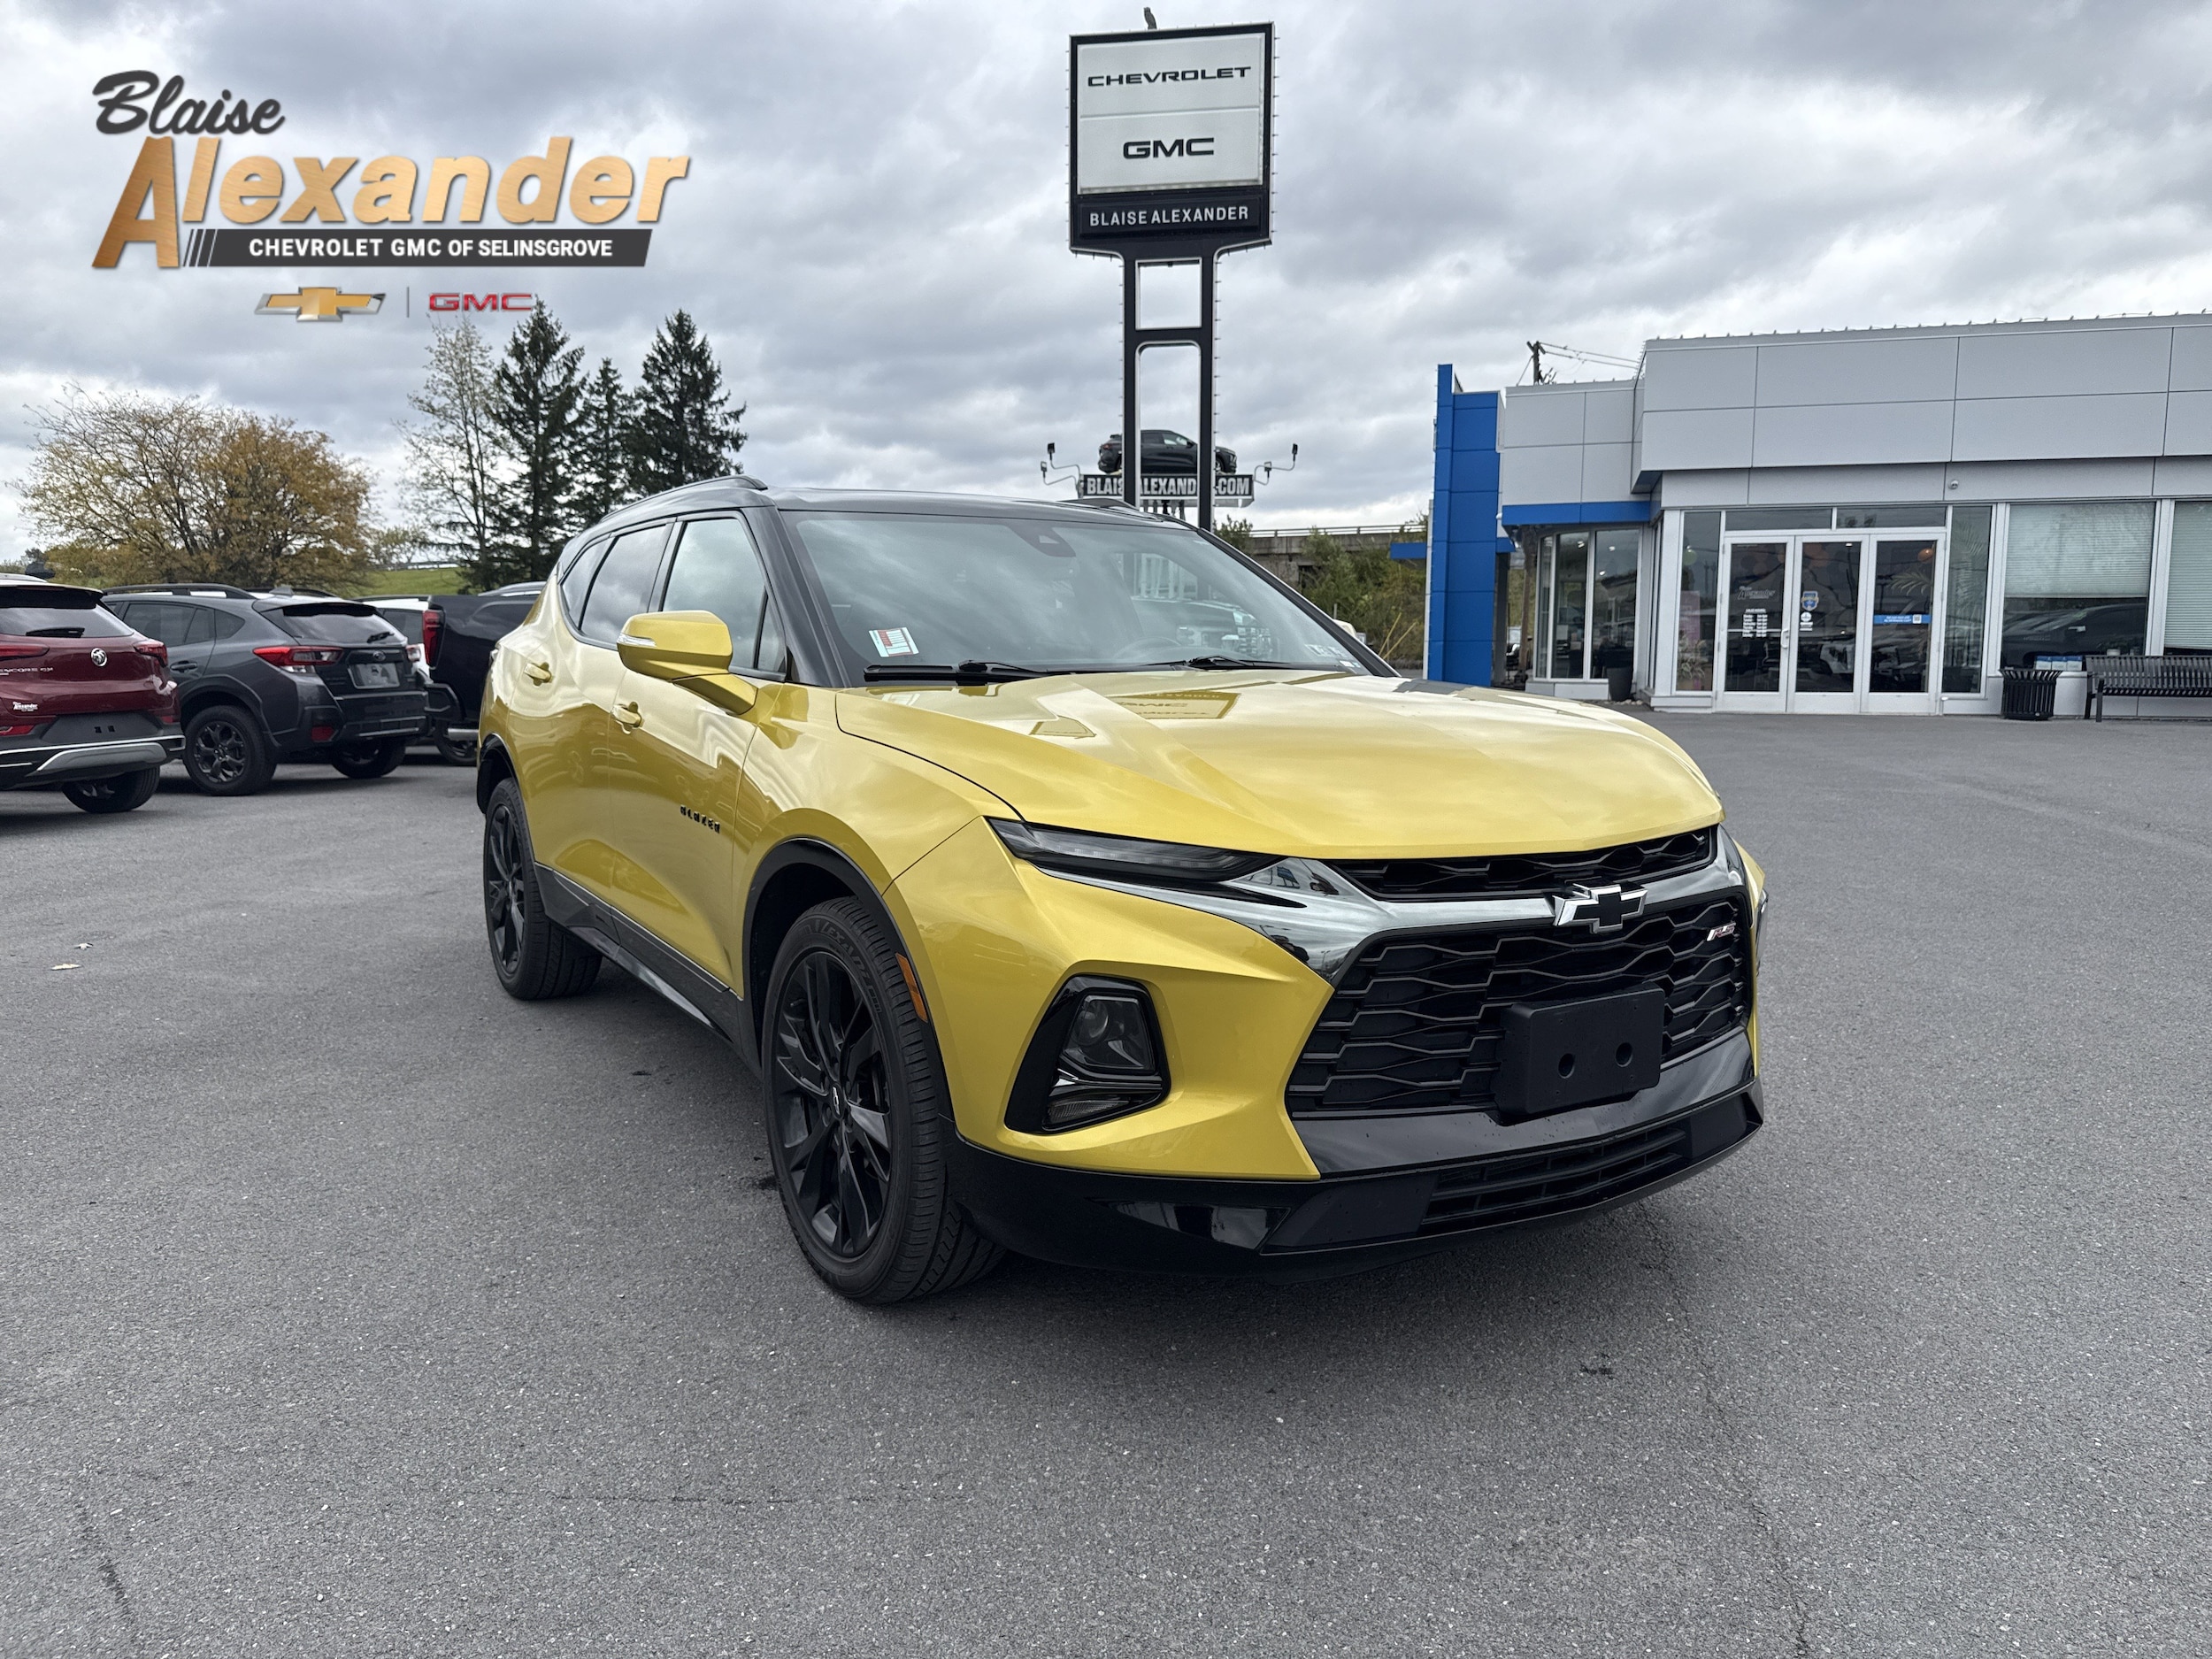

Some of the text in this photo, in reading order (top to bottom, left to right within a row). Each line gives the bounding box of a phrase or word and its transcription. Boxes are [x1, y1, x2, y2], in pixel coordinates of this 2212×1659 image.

[1087, 65, 1252, 87] CHEVROLET
[1123, 137, 1215, 159] GMC
[1089, 205, 1249, 227] BLAISE ALEXANDER
